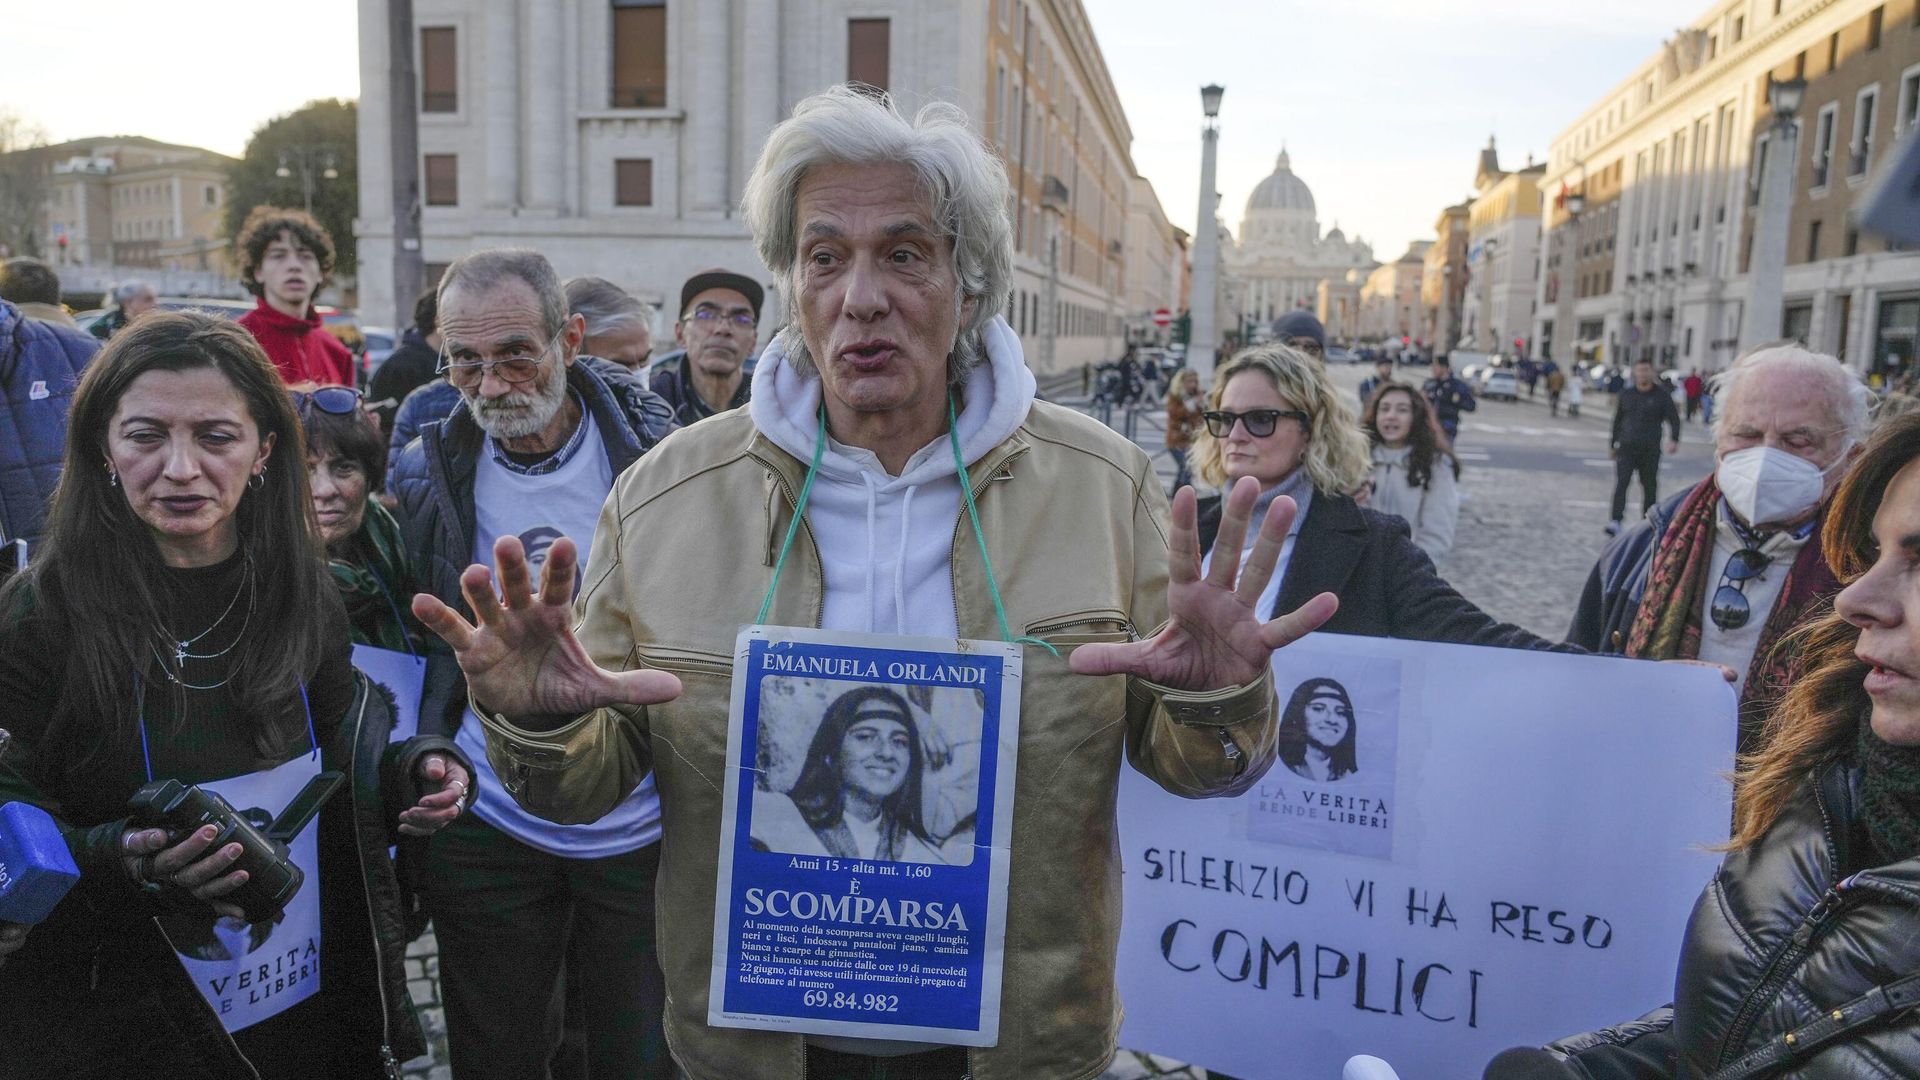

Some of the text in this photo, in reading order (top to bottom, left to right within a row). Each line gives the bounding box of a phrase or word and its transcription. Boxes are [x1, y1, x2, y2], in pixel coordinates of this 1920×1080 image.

[762, 653, 986, 684] EMANUELA ORLANDI
[1260, 785, 1286, 800] LA
[1259, 801, 1387, 828] RENDE LIBERI
[789, 857, 819, 870] Anni
[825, 859, 839, 871] 15
[852, 862, 875, 874] alta
[879, 865, 899, 875] mt.
[905, 866, 931, 878] 1,60
[850, 878, 860, 895] È
[1143, 847, 1613, 949] SILENZIO VI HA RESO
[745, 888, 969, 931] SCOMPARSA
[743, 920, 753, 928] Al
[757, 921, 799, 932] momento
[802, 925, 823, 934] della
[826, 928, 873, 938] scomparsa
[905, 933, 934, 942] capelli
[938, 934, 969, 945] lunghi,
[778, 934, 797, 943] lisci,
[804, 936, 847, 946] indossava
[854, 941, 896, 949] pantaloni
[902, 944, 927, 952] jeans,
[934, 946, 968, 954] camicia
[742, 941, 771, 951] bianca
[783, 947, 811, 956] scarpe
[829, 949, 876, 959] ginnastica.
[740, 963, 966, 987] 22 giugno, chi avesse utili informazioni è pregato di
[741, 952, 760, 961] Non
[763, 954, 770, 962] si
[773, 955, 801, 964] hanno
[822, 960, 852, 968] notizie
[855, 961, 876, 970] dalle
[898, 964, 908, 972] 19
[911, 964, 919, 973] di
[923, 966, 967, 976] mercoledì
[1161, 918, 1483, 1029] COMPLICI
[249, 960, 318, 1004] LIBERI
[740, 975, 834, 989] telefonare al numero
[803, 990, 899, 1013] 69.84.982
